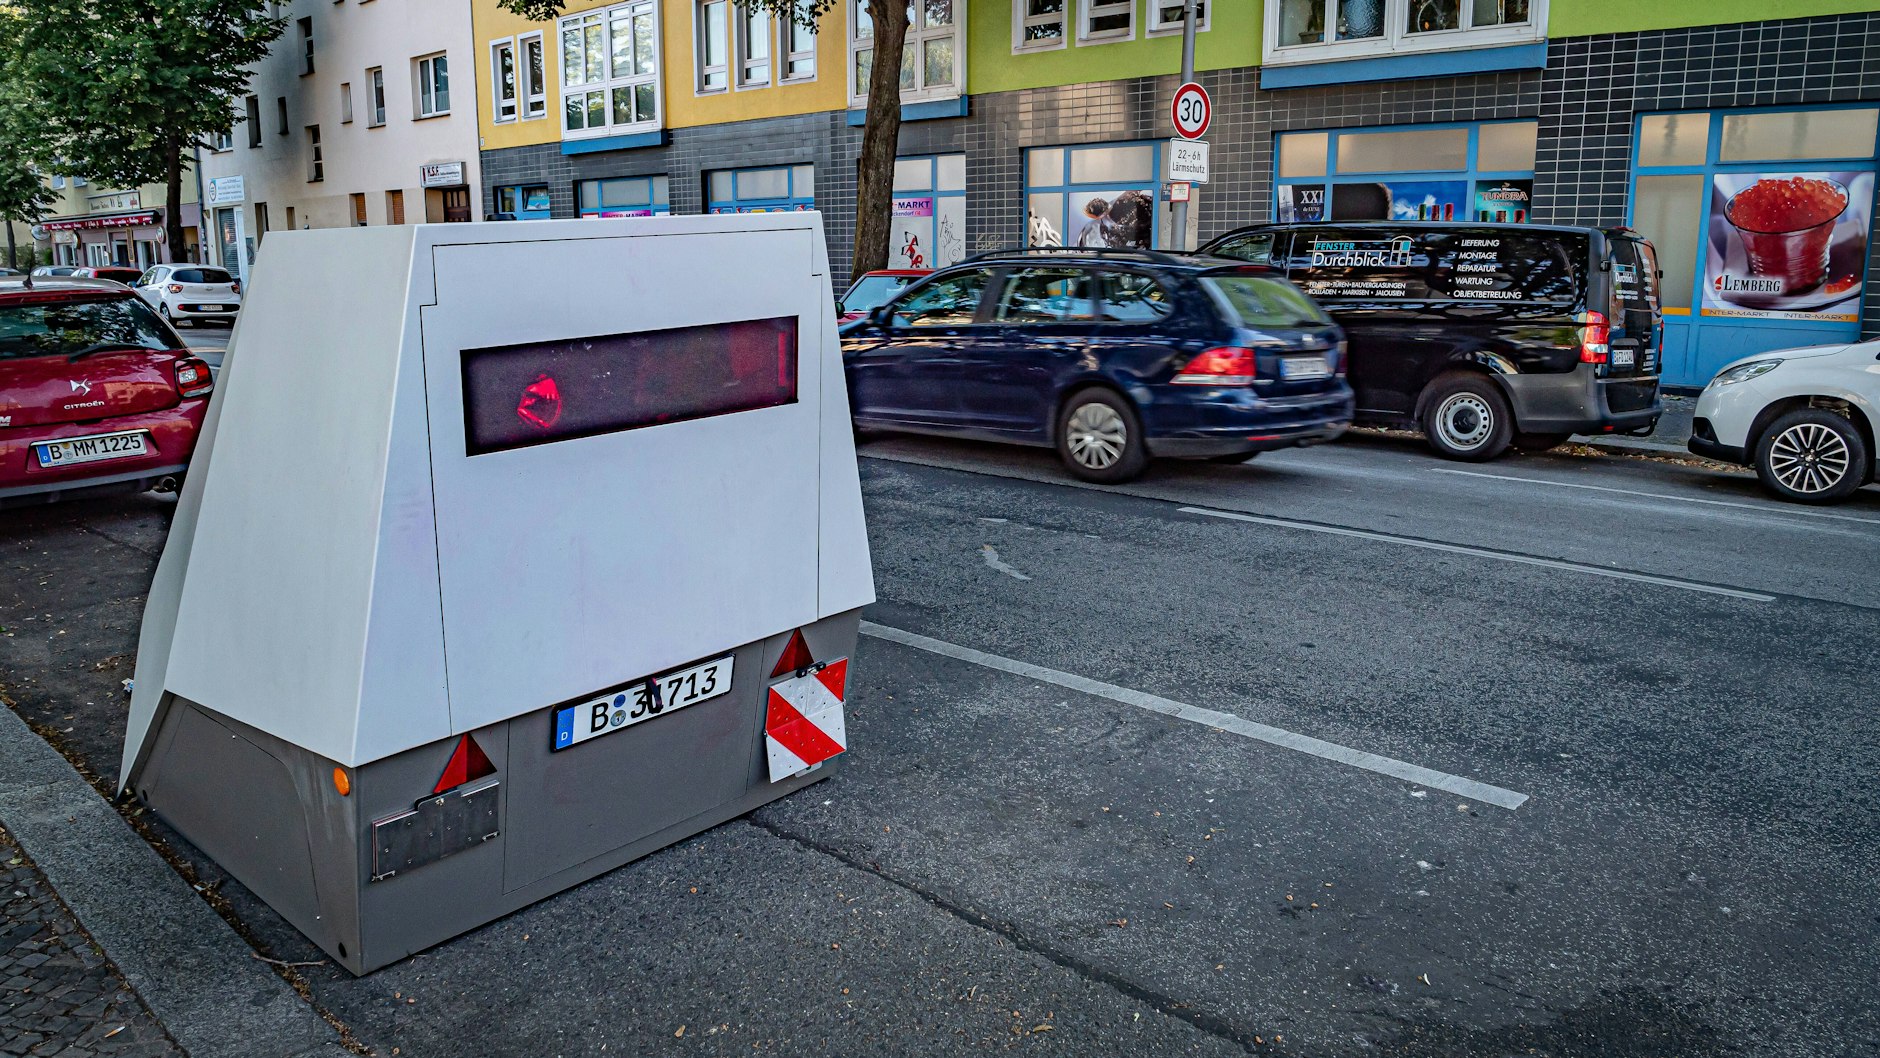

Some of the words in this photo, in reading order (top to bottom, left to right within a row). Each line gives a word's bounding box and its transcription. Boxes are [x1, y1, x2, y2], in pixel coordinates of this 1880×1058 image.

[1180, 97, 1202, 123] 30
[1172, 161, 1205, 174] Lärmschutz
[1480, 191, 1528, 201] TUNDRA
[1315, 242, 1355, 251] FENSTER
[1461, 239, 1500, 247] LIEFERUNG
[1312, 252, 1386, 267] Durchblick
[1458, 252, 1497, 260] MONTAGE
[1456, 264, 1496, 273] REPARATUR
[1455, 276, 1493, 285] WARTUNG
[1723, 274, 1781, 292] LEMBERG
[1453, 289, 1522, 300] OBJEKTBETREUUNG
[1708, 309, 1771, 317] INTER-MARKT
[1783, 312, 1851, 321] INTER-MARKT
[50, 445, 62, 460] B
[72, 440, 98, 457] MM
[99, 435, 141, 453] 1225
[561, 731, 568, 741] D
[590, 702, 609, 733] B
